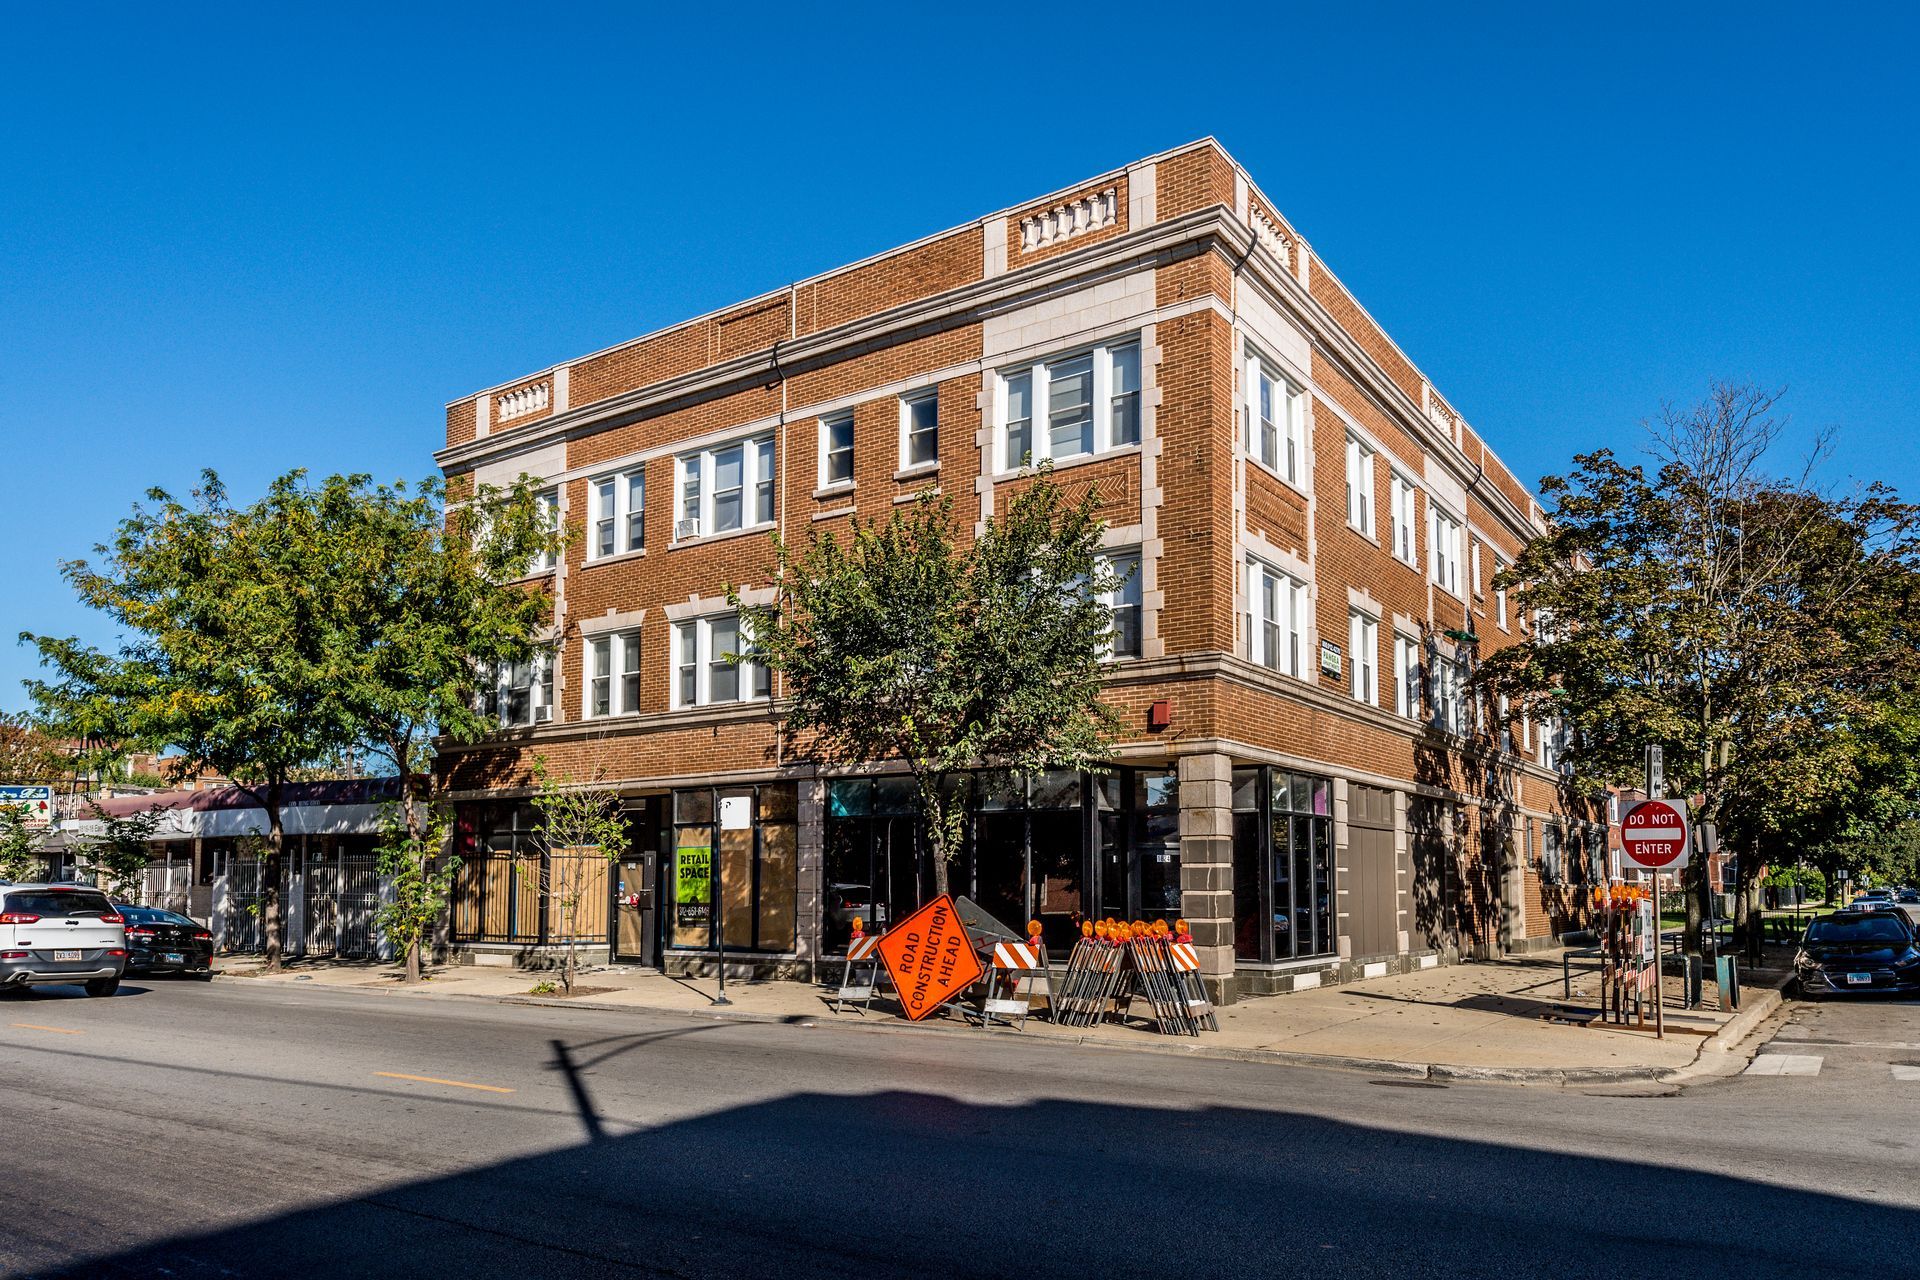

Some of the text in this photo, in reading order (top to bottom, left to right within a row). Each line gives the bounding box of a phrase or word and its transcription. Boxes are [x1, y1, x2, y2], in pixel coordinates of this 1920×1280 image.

[1629, 814, 1675, 825] DO NOT
[1635, 843, 1672, 854] ENTER
[680, 855, 709, 864] RETAIL
[680, 868, 709, 879] SPACE
[900, 932, 920, 974] ROAD
[911, 906, 948, 1010] CONSTRUCTION
[937, 936, 961, 987] AHEAD
